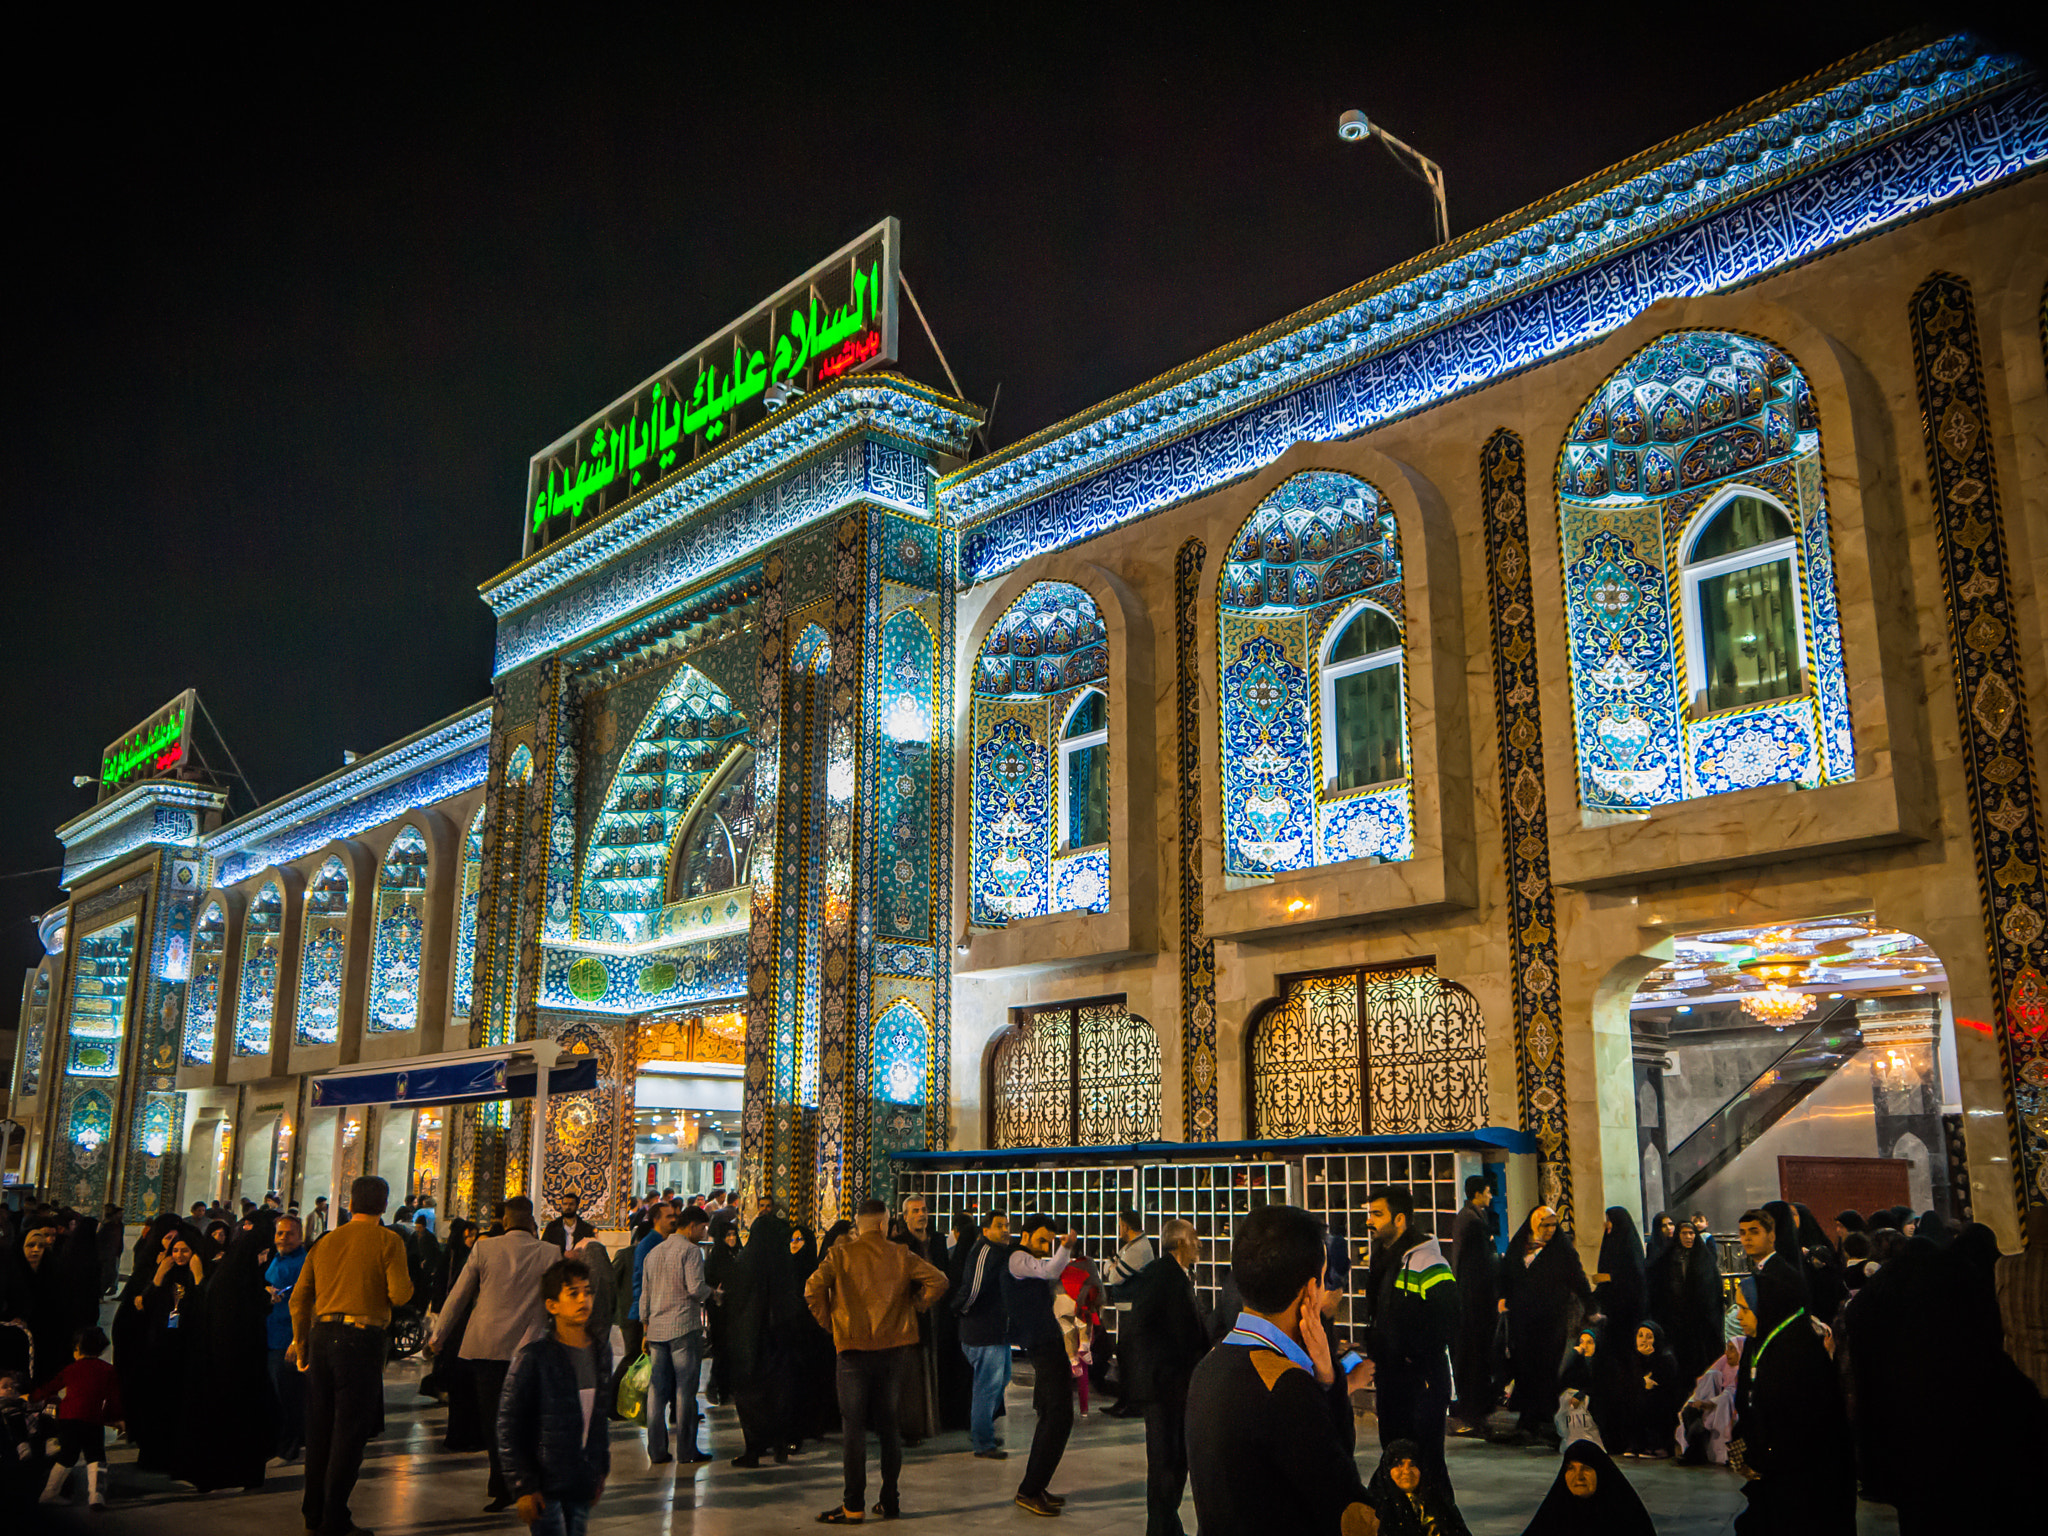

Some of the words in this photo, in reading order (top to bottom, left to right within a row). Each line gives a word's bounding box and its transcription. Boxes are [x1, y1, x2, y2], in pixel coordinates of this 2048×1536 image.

[771, 260, 878, 385] السلام
[682, 347, 767, 441] عليك
[532, 424, 626, 534] الشهداء
